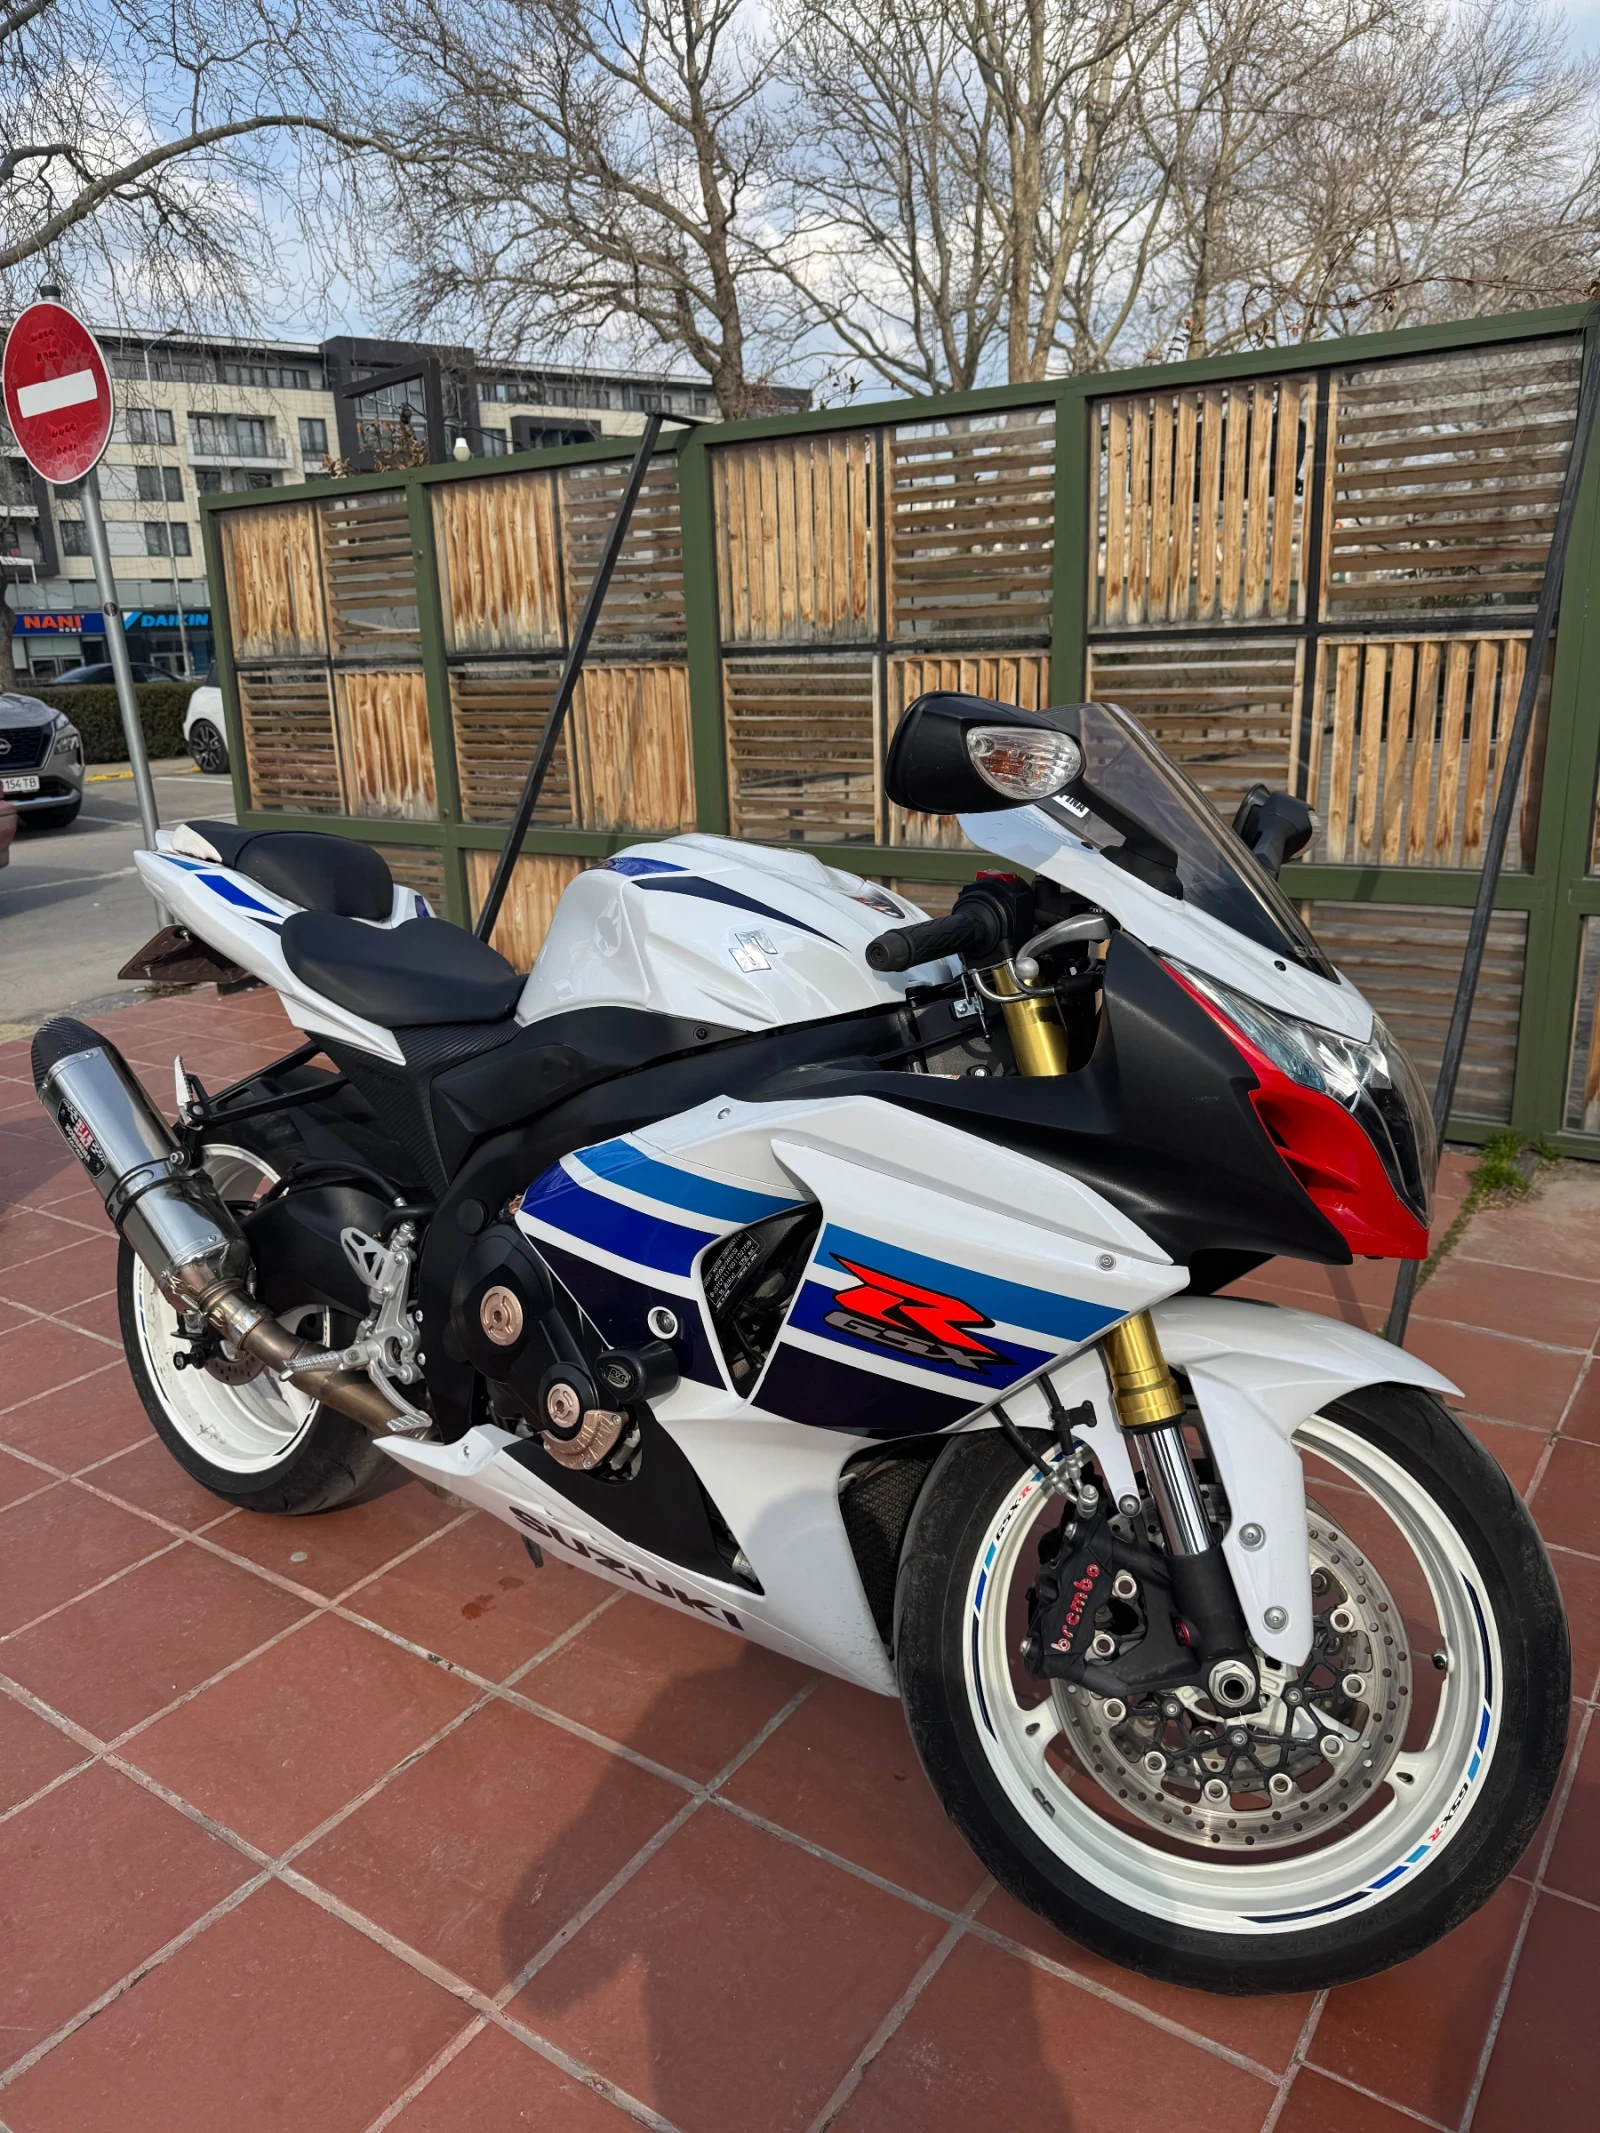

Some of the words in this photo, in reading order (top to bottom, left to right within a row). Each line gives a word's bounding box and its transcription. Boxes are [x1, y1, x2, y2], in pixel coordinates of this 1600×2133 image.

[24, 615, 82, 629] NANI
[141, 614, 209, 628] DAIKIN
[824, 1311, 1000, 1371] GSX
[508, 1506, 745, 1632] SUZUKI
[1051, 1563, 1100, 1653] brembo
